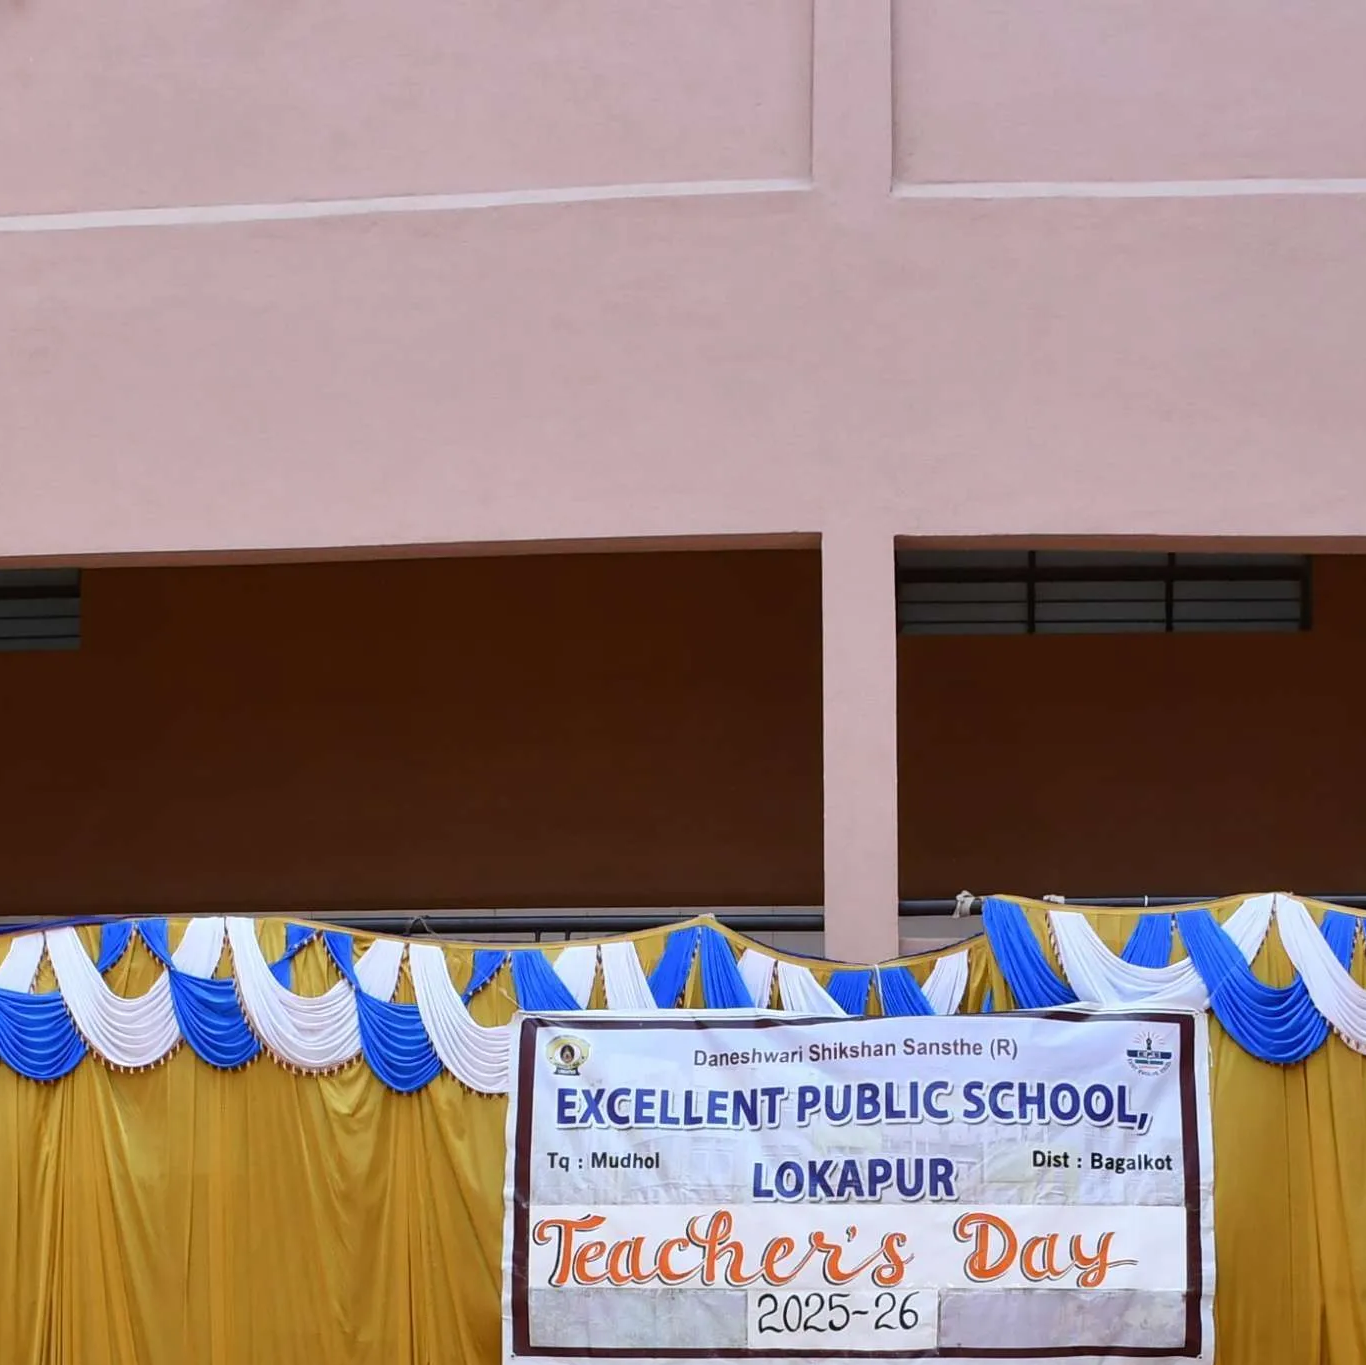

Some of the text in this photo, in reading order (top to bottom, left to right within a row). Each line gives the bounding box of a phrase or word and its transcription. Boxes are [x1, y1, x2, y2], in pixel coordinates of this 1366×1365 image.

[694, 1038, 1018, 1067] Daneshwari Shikshan Sansthe (R)
[556, 1081, 1149, 1130] EXCELLENT PUBLIC SCHOOL,
[546, 1152, 570, 1172] Tq
[590, 1151, 660, 1169] Mudhol
[752, 1158, 955, 1198] LOKAPUR
[1032, 1150, 1070, 1168] Dist
[1090, 1152, 1173, 1174] Bagalkot
[532, 1209, 1139, 1288] Teacher's Day
[757, 1290, 920, 1334] 2025-26
